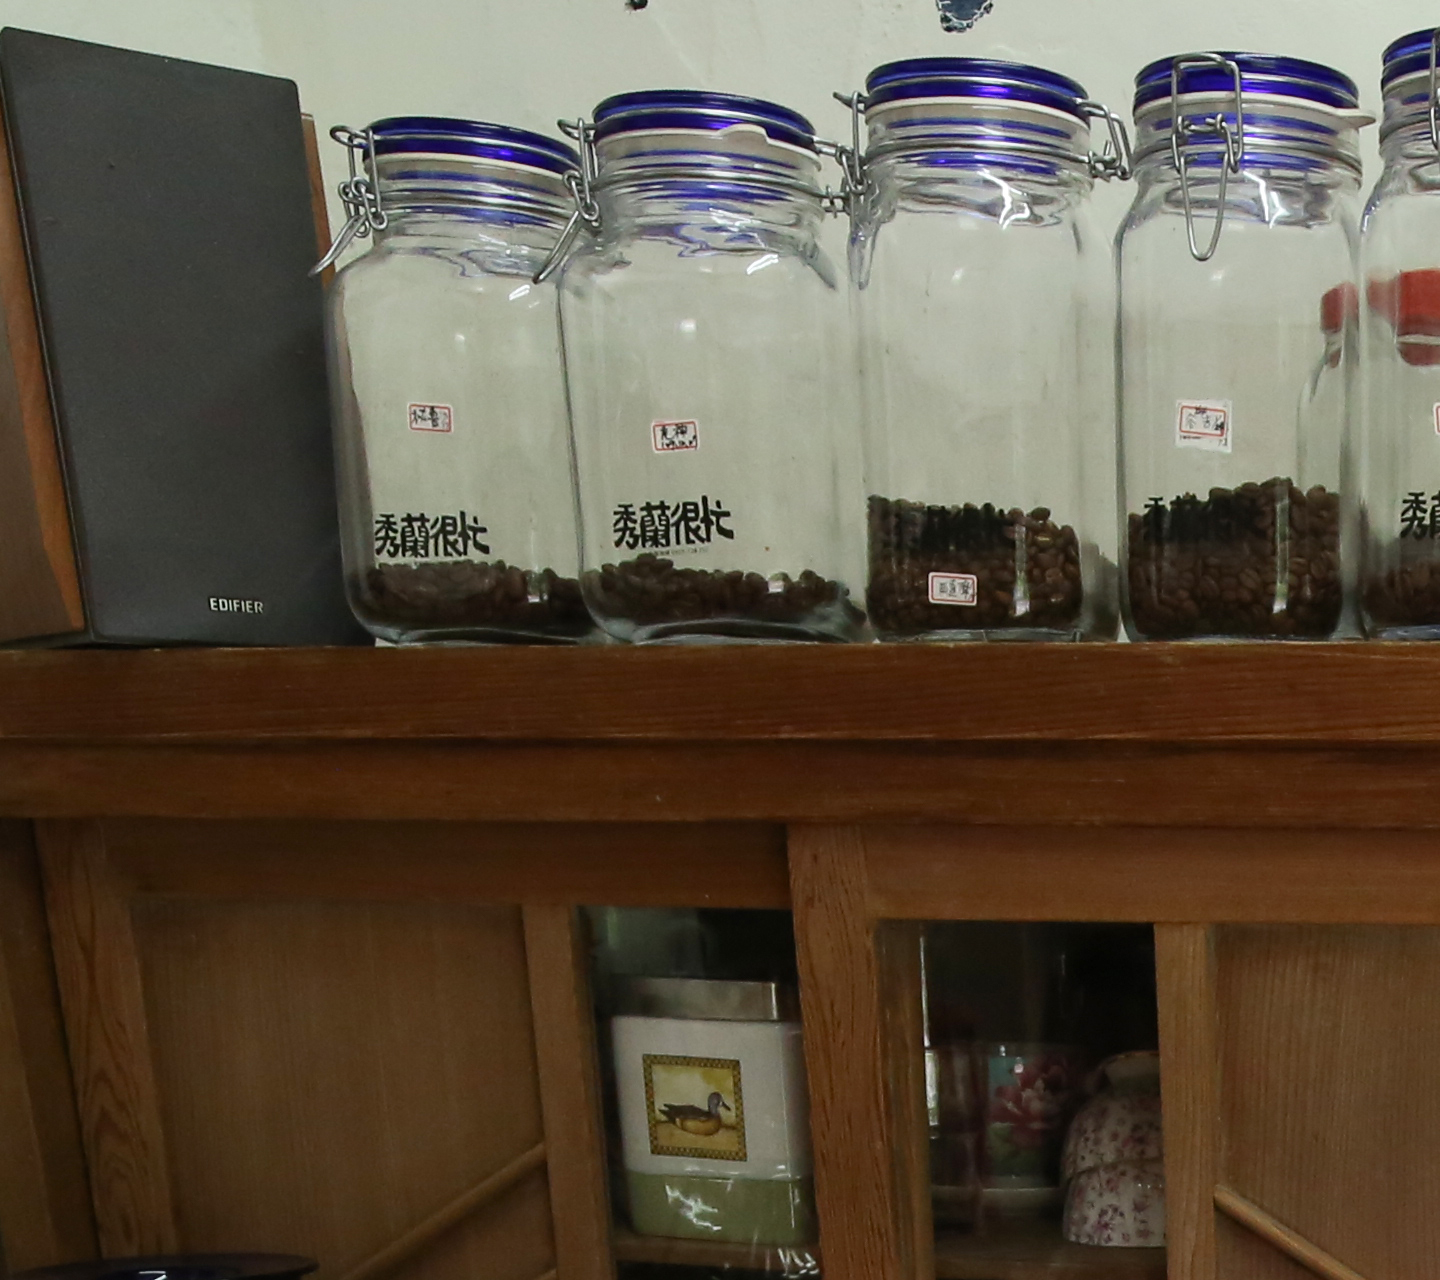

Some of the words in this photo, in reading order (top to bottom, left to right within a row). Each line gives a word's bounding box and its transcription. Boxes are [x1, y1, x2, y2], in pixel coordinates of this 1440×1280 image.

[374, 511, 490, 559] 秀蘭很忙
[613, 495, 735, 550] 秀蘭很忙
[209, 597, 264, 614] EDIFIER
